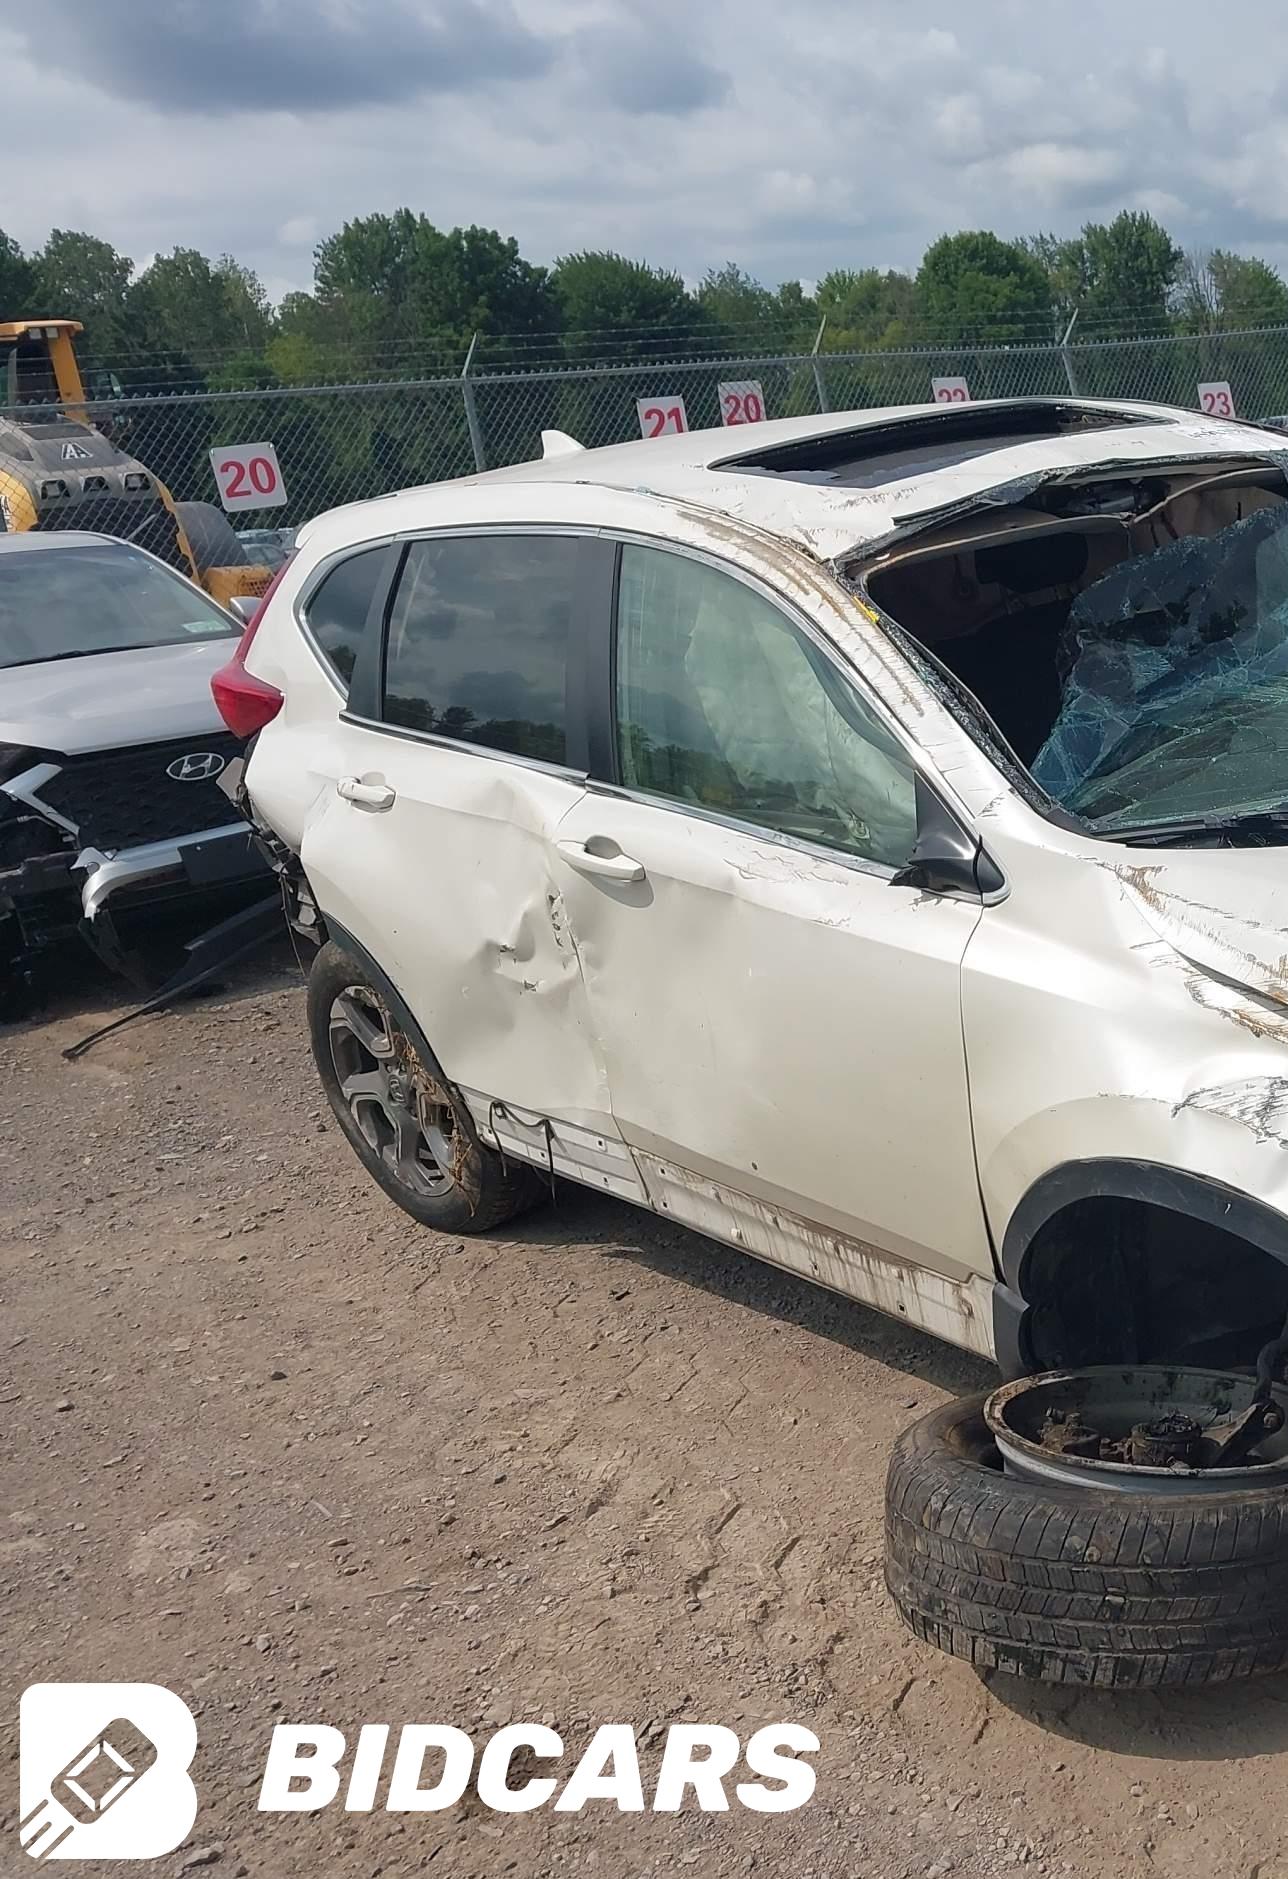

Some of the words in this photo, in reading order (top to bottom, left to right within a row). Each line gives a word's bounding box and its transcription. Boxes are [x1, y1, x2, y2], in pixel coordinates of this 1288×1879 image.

[726, 393, 761, 426] 20
[1203, 391, 1231, 416] 23
[644, 406, 684, 438] 21
[220, 457, 277, 499] 20
